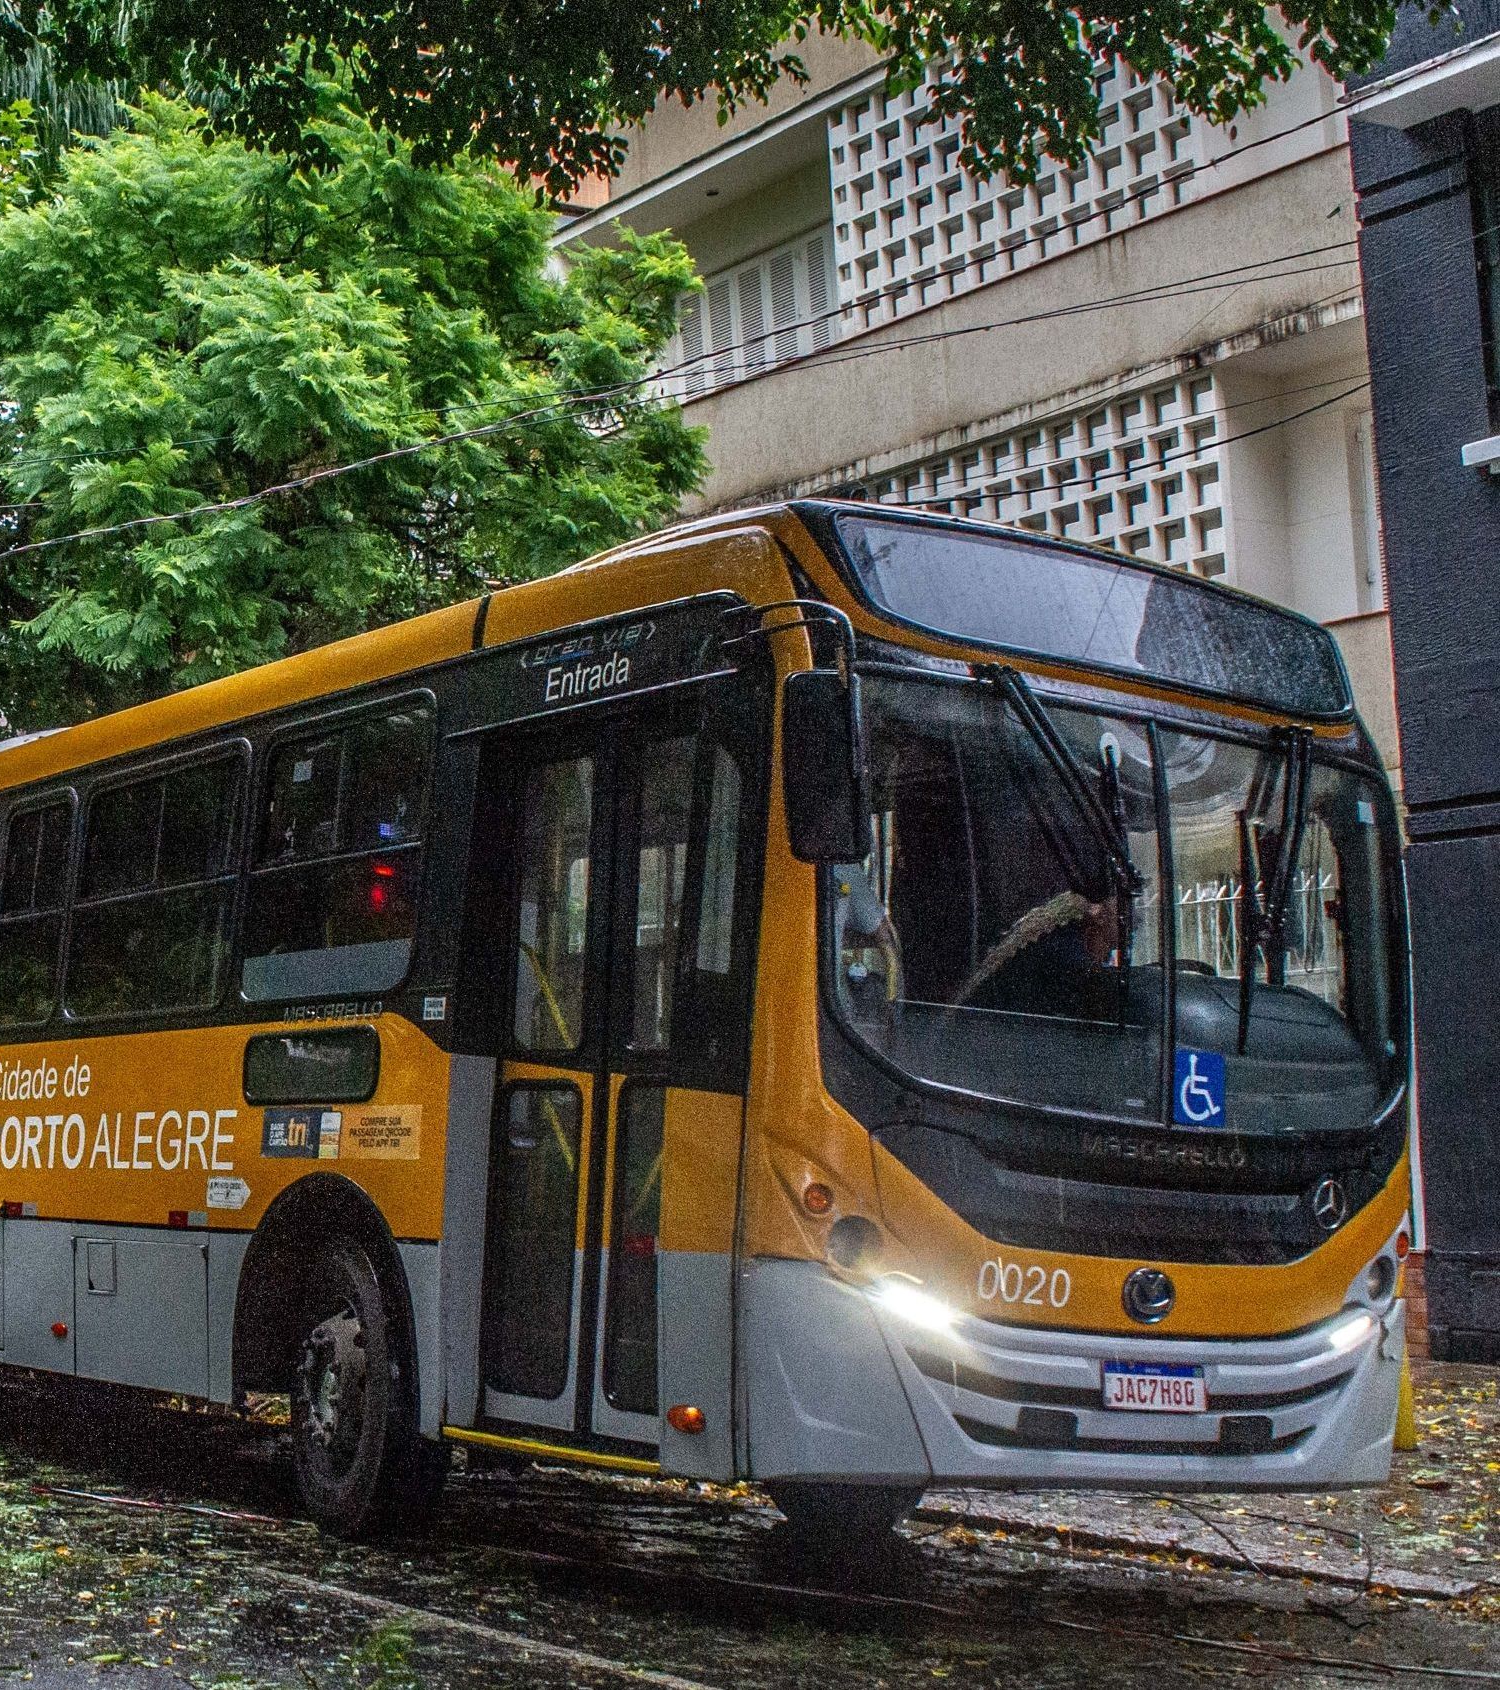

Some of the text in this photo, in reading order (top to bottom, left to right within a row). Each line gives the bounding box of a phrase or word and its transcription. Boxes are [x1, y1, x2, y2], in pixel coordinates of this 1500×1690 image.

[544, 651, 630, 702] Entrada
[283, 1001, 383, 1023] MASCARELLO
[63, 1055, 91, 1098] de
[90, 1109, 238, 1171] ALEGRE
[349, 1127, 383, 1137] PASSAGEM
[360, 1116, 387, 1126] COMPRE
[1081, 1132, 1247, 1168] MASCARELLO
[977, 1260, 1071, 1308] 0020
